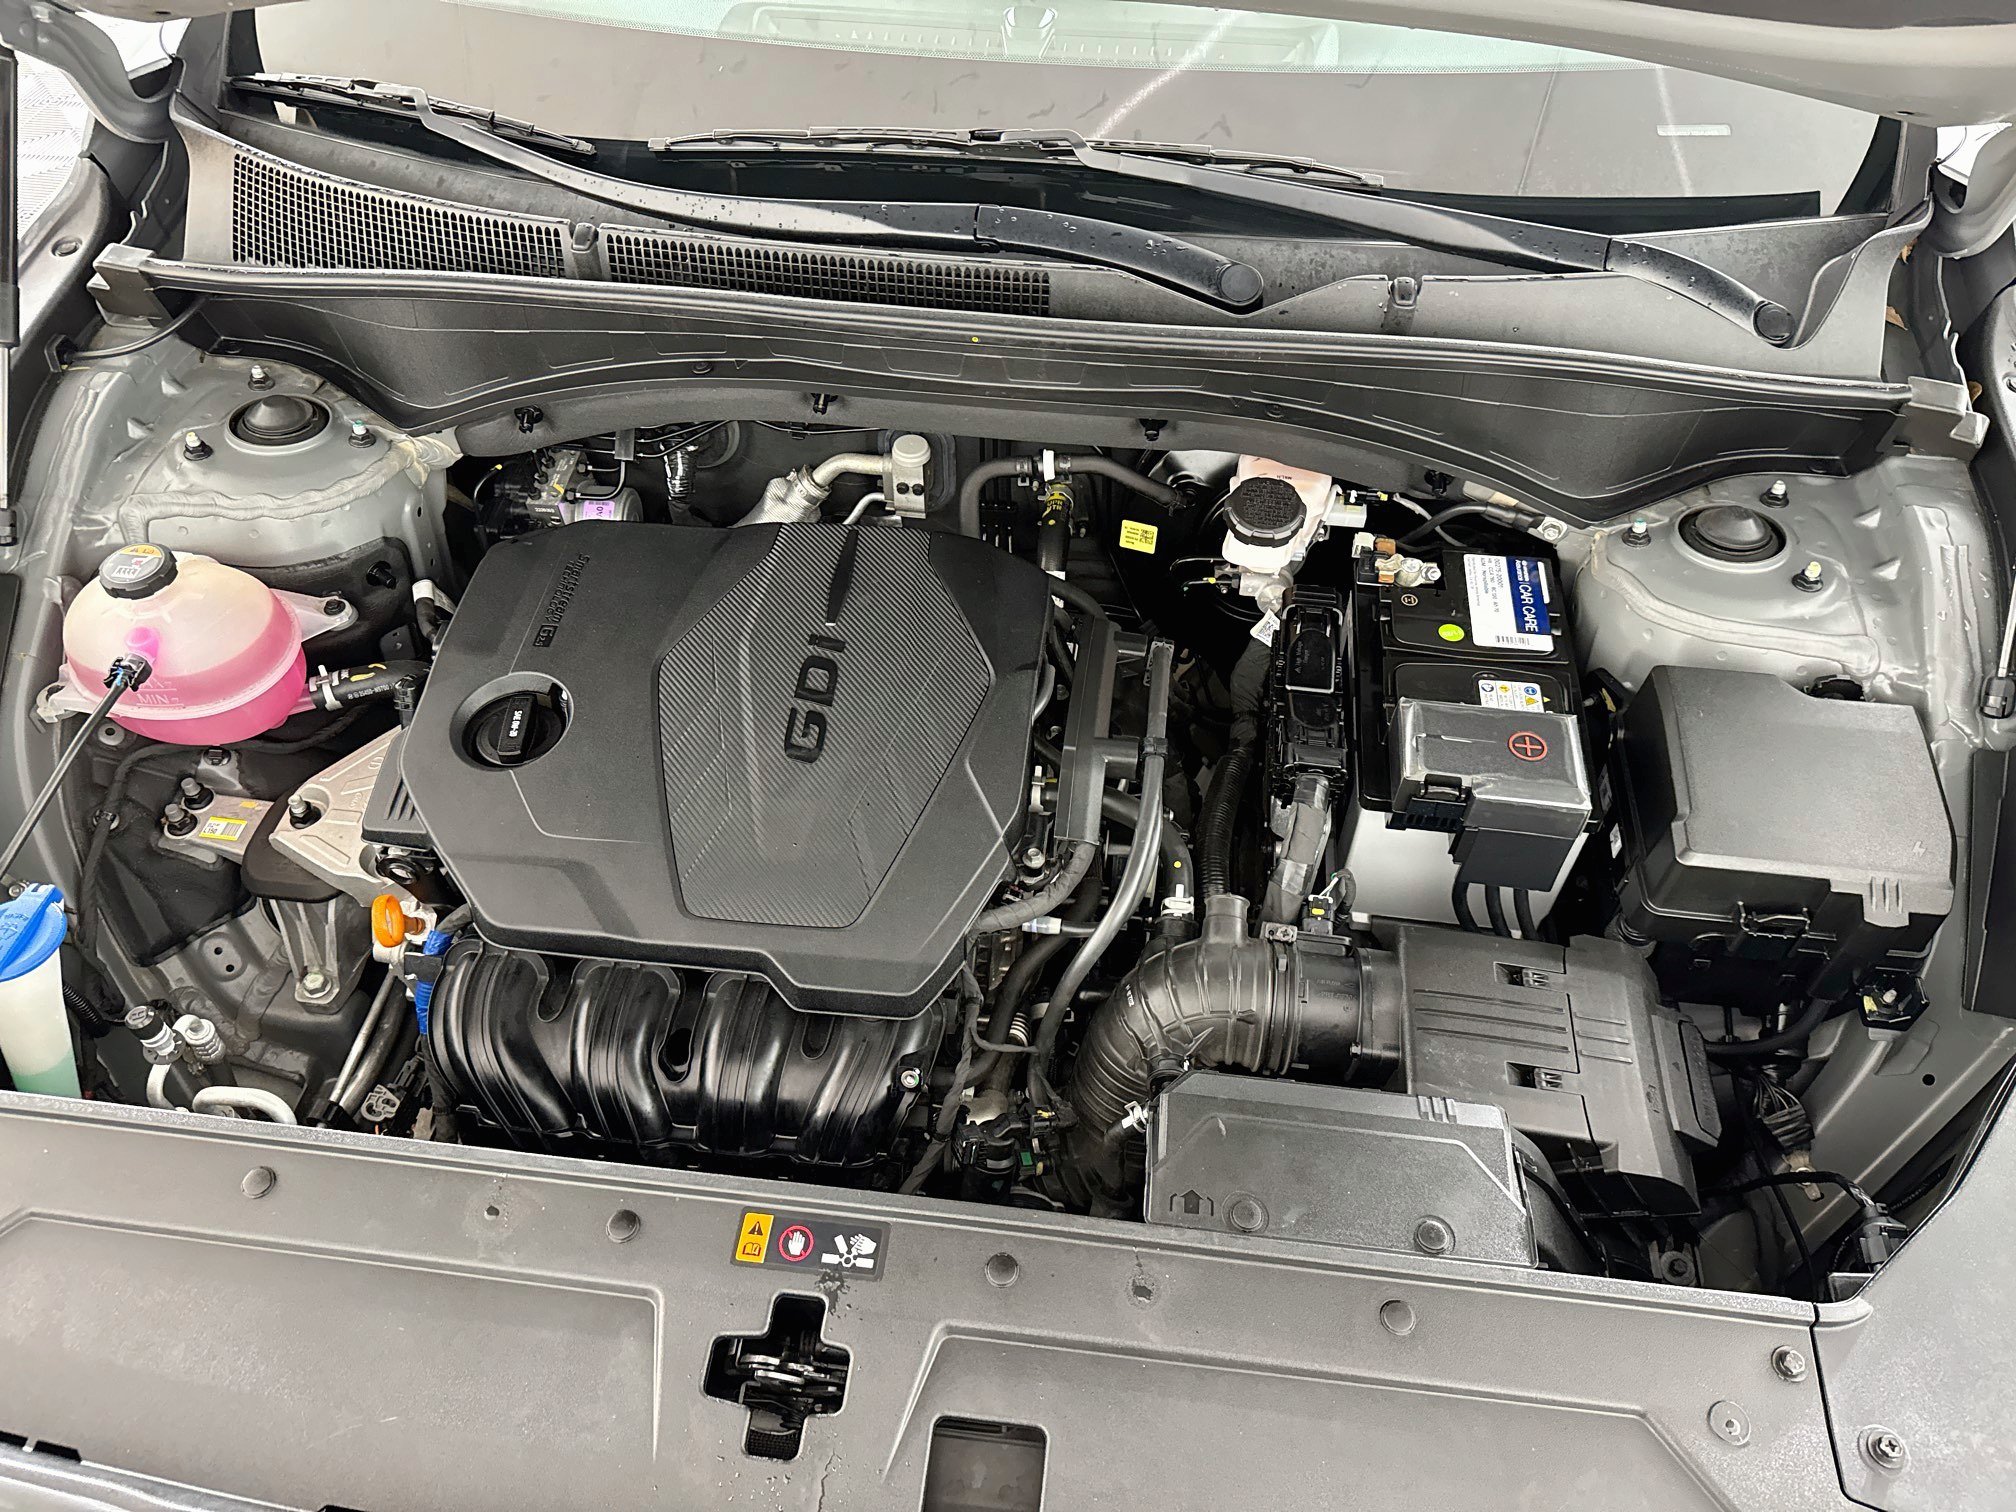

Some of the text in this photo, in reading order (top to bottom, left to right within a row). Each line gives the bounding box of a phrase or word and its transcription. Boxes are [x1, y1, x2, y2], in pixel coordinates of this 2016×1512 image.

[545, 560, 575, 621] TECHNOLOGY
[552, 553, 590, 623] Smartstream
[1519, 584, 1534, 604] CAR
[1522, 606, 1538, 632] CARE
[136, 693, 170, 705] MIN
[512, 710, 523, 721] SAE
